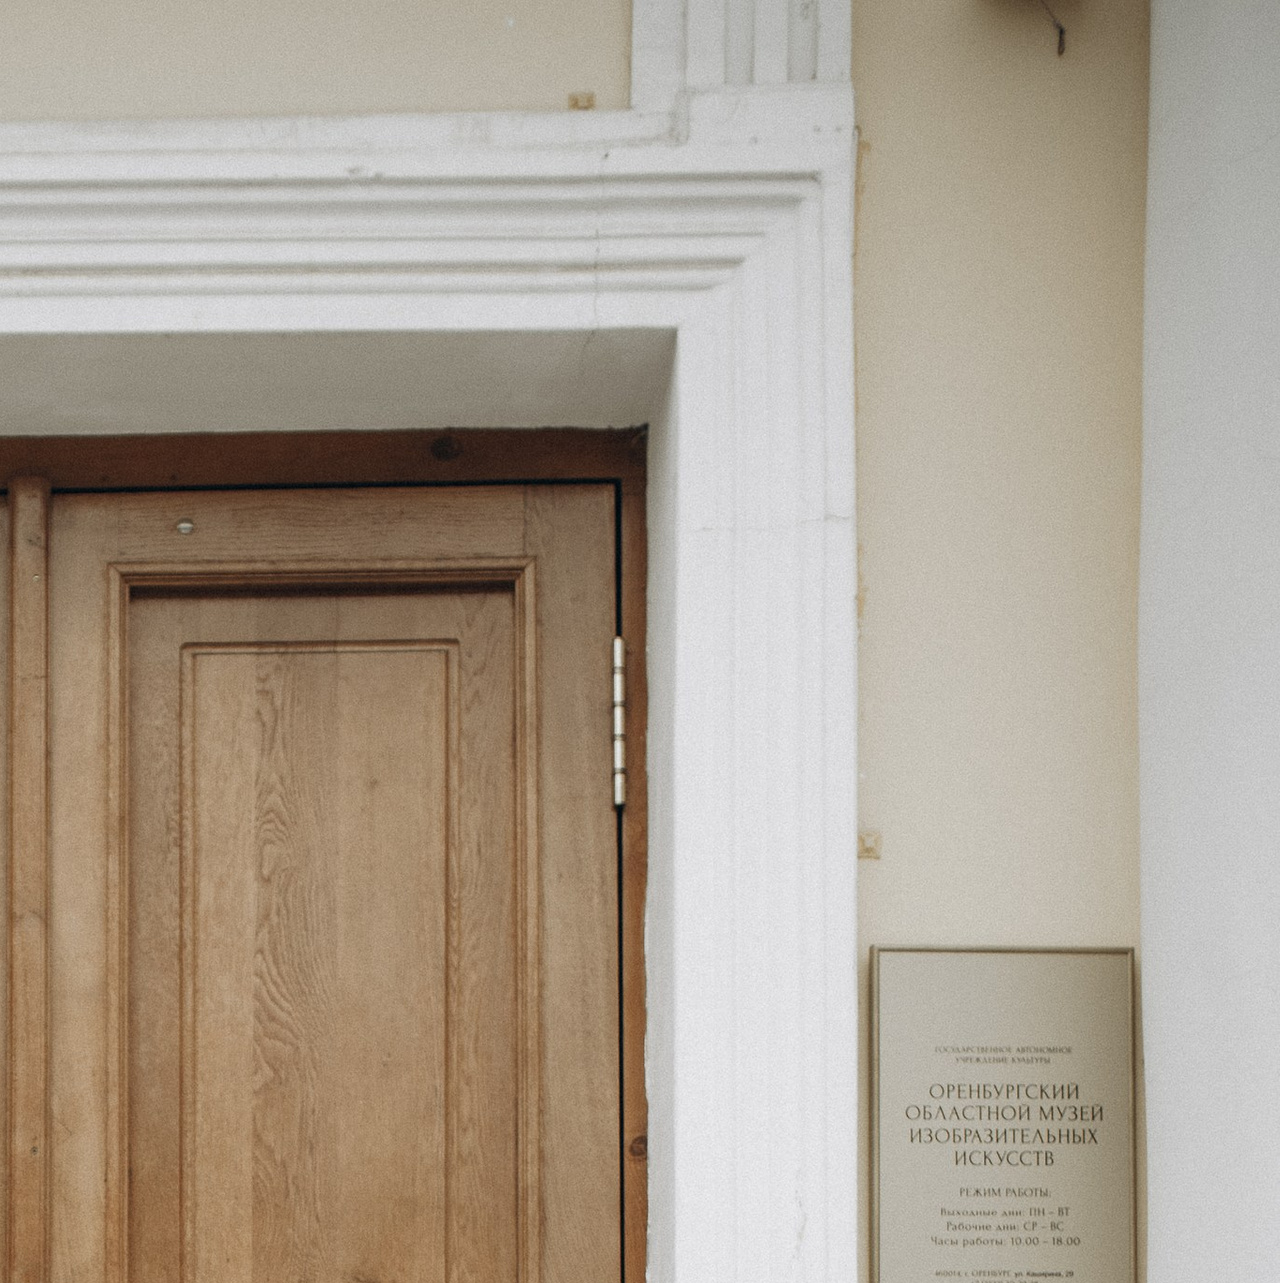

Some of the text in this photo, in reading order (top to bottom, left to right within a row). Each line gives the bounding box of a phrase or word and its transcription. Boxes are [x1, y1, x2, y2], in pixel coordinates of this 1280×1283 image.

[928, 1082, 1080, 1100] ОРЕНБУРГСКИЙ
[905, 1104, 1104, 1121] ОБЛАСТНОЙ МУЗЕЙ
[909, 1128, 1099, 1144] ИЗОБРАЗИТЕЛЬНЫХ
[954, 1150, 1055, 1166] ИСКУССТВ
[959, 1187, 1052, 1198] РЕЖИМ РАБОТЫ:
[940, 1207, 998, 1217] Выходные
[1029, 1207, 1045, 1217] ПН
[1057, 1206, 1071, 1216] ВТ
[946, 1222, 992, 1231] Рабочие
[1023, 1221, 1038, 1231] СР
[1050, 1221, 1065, 1231] ВС
[930, 1236, 959, 1246] Часы
